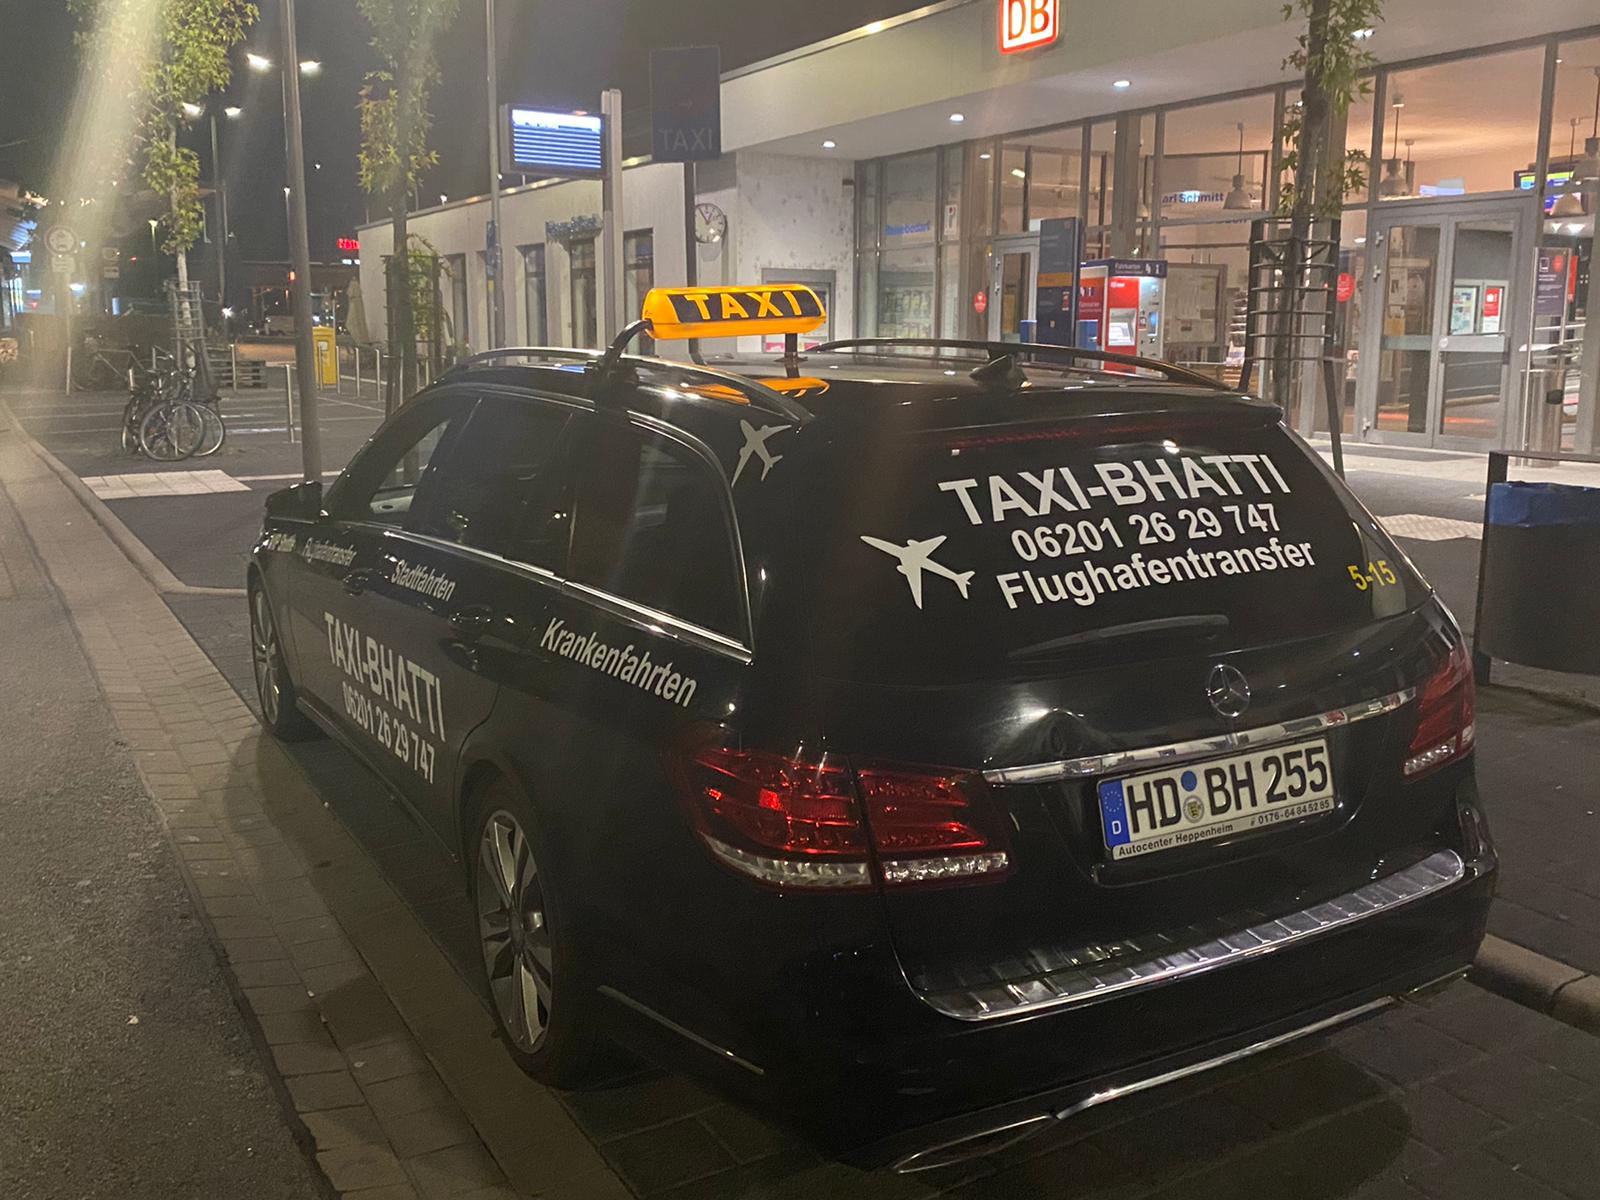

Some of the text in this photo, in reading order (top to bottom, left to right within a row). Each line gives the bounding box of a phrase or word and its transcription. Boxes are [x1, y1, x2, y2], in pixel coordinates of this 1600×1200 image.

[1008, 0, 1050, 40] DB
[657, 127, 713, 151] TAXI
[1160, 191, 1224, 204] arl Schmitt
[684, 291, 802, 321] TAXI
[938, 453, 1291, 525] TAXI-BHATTI
[1011, 502, 1280, 561] 06201 26 29 747
[391, 559, 456, 602] Stadtfahrten
[997, 539, 1316, 609] Flughafentransfer
[1347, 560, 1396, 590] 5-15
[324, 611, 446, 743] TAXI-BHATTI
[540, 617, 698, 707] Krankenfahrten
[342, 681, 435, 785] 06201 26 29 747
[1126, 746, 1328, 833] HD BH 255
[1112, 820, 1122, 835] D
[1118, 837, 1173, 857] Autocenter
[1175, 824, 1234, 844] Heppenheim
